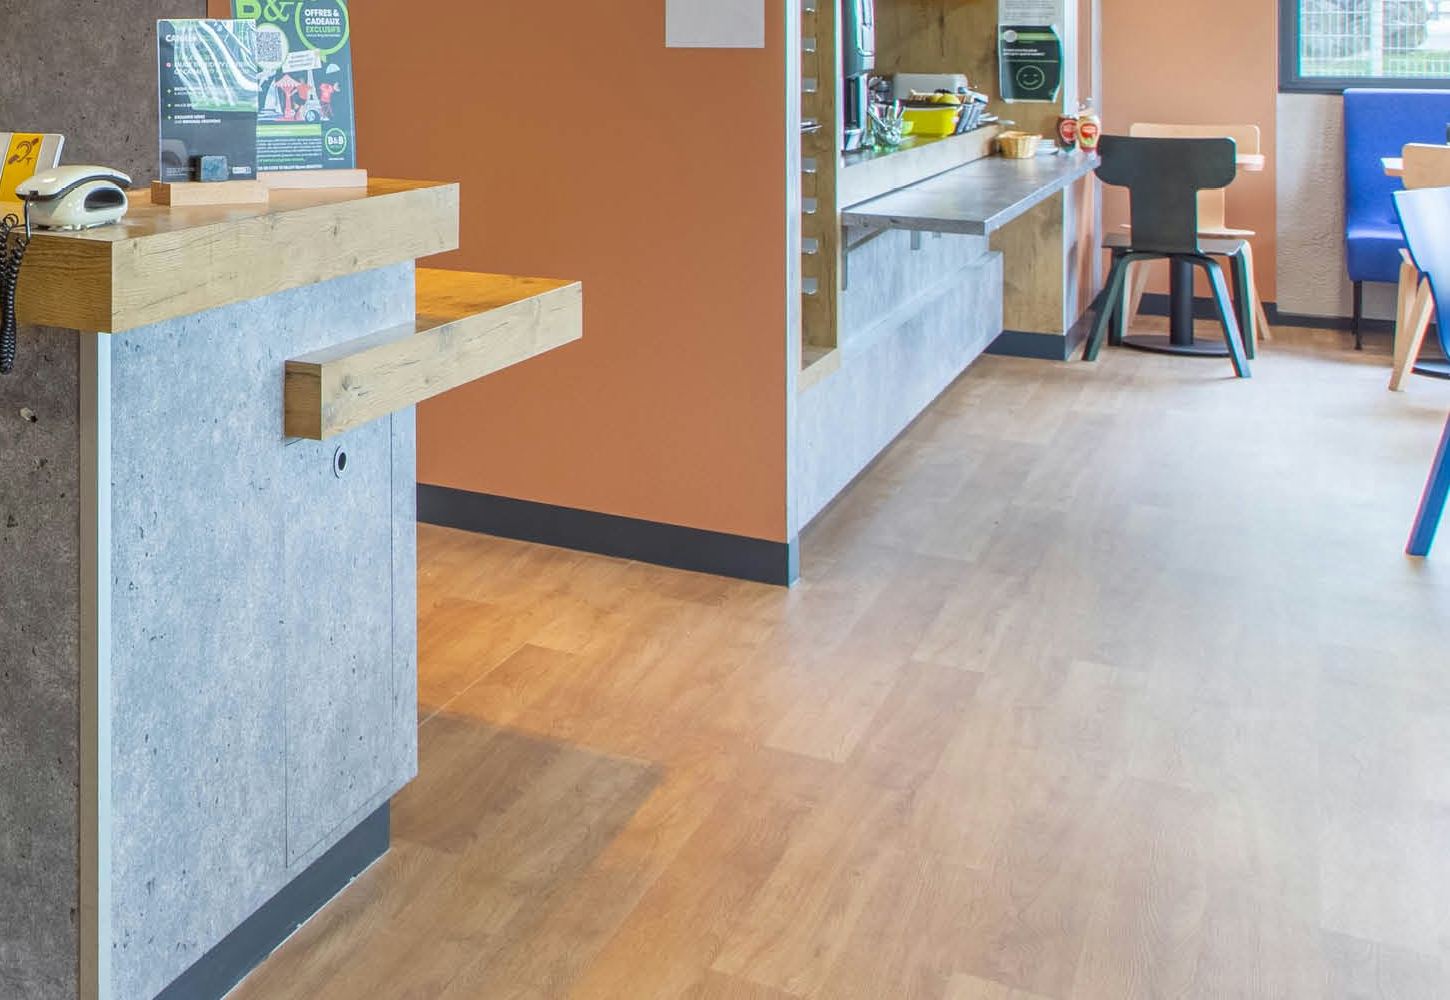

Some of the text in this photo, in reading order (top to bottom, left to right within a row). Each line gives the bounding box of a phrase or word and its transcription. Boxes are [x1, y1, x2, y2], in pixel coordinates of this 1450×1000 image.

[304, 8, 340, 17] OFFRES &
[305, 17, 341, 26] CADEAUX
